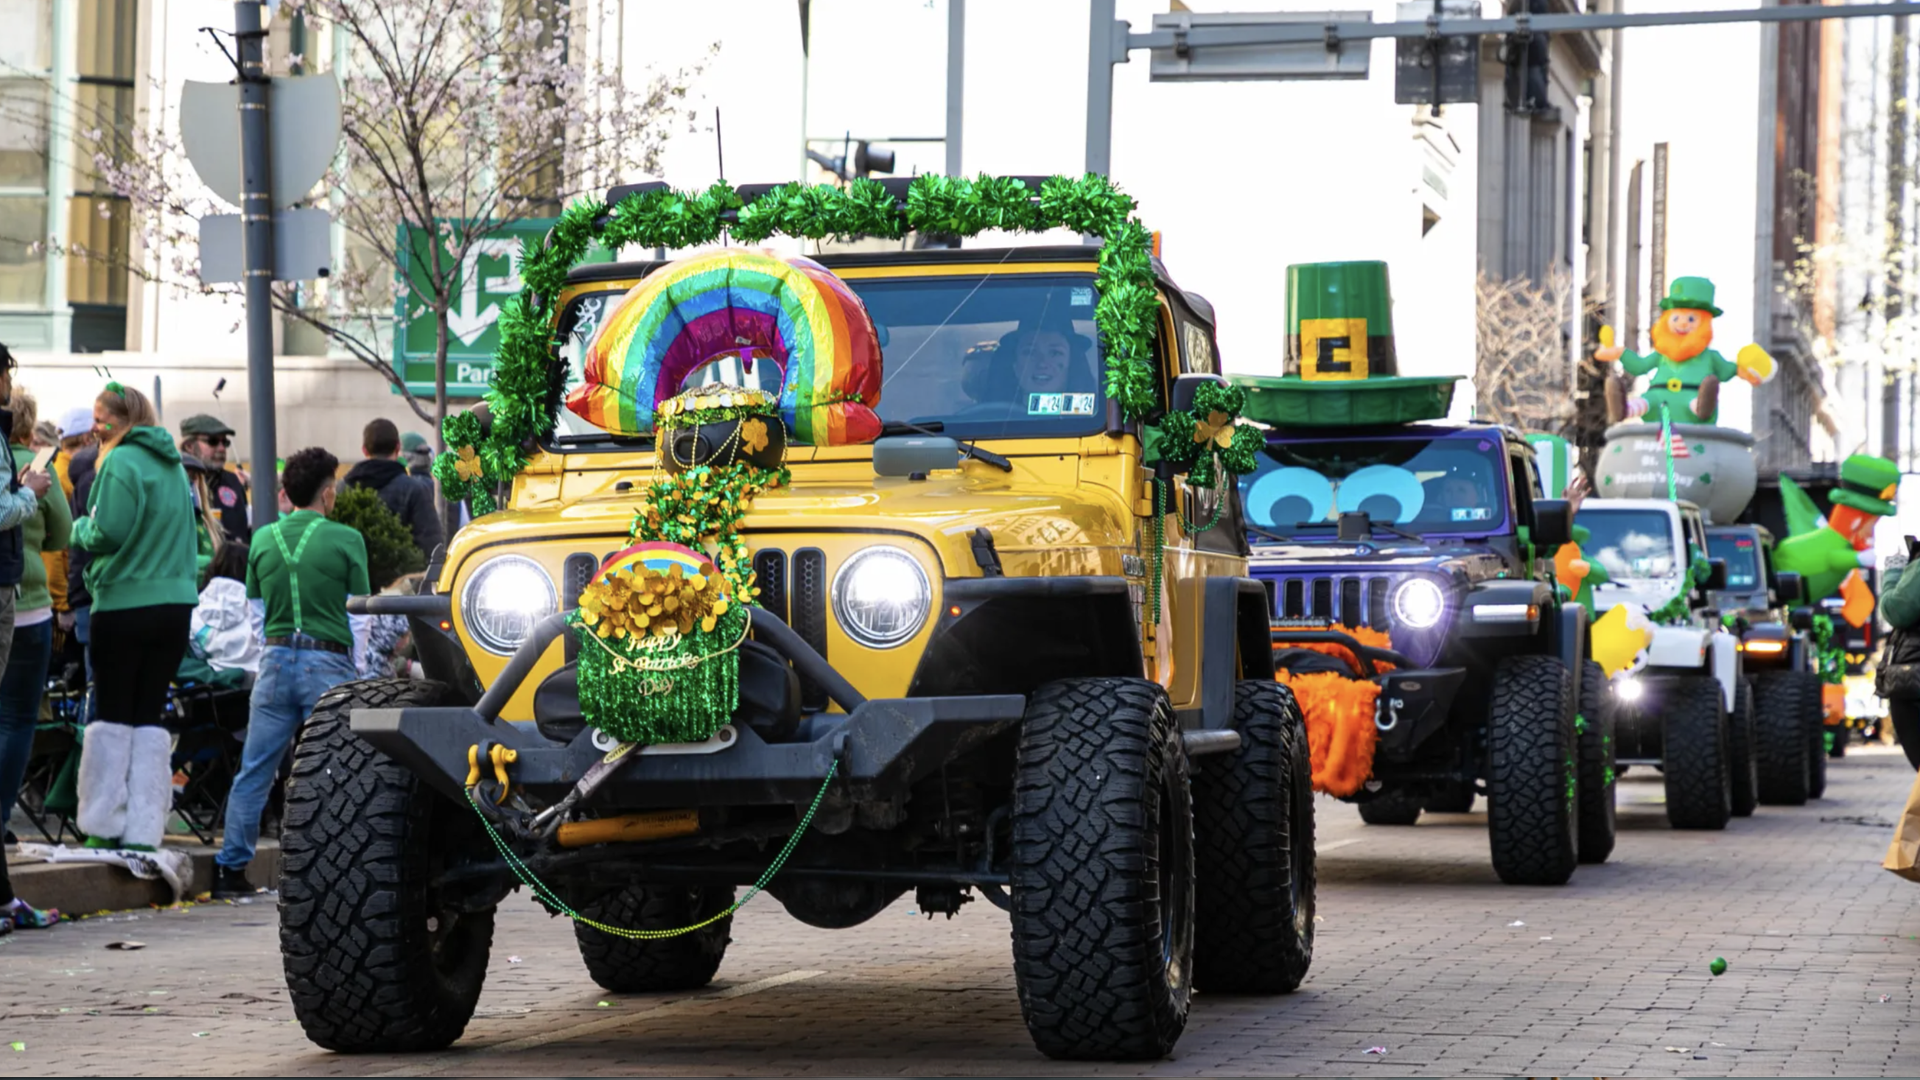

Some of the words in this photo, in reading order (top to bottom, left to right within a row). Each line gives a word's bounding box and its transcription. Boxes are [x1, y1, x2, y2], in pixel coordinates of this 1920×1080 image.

[1051, 396, 1060, 411] 24
[1084, 396, 1093, 411] 24
[1634, 440, 1663, 452] Hap
[638, 677, 675, 696] Day
